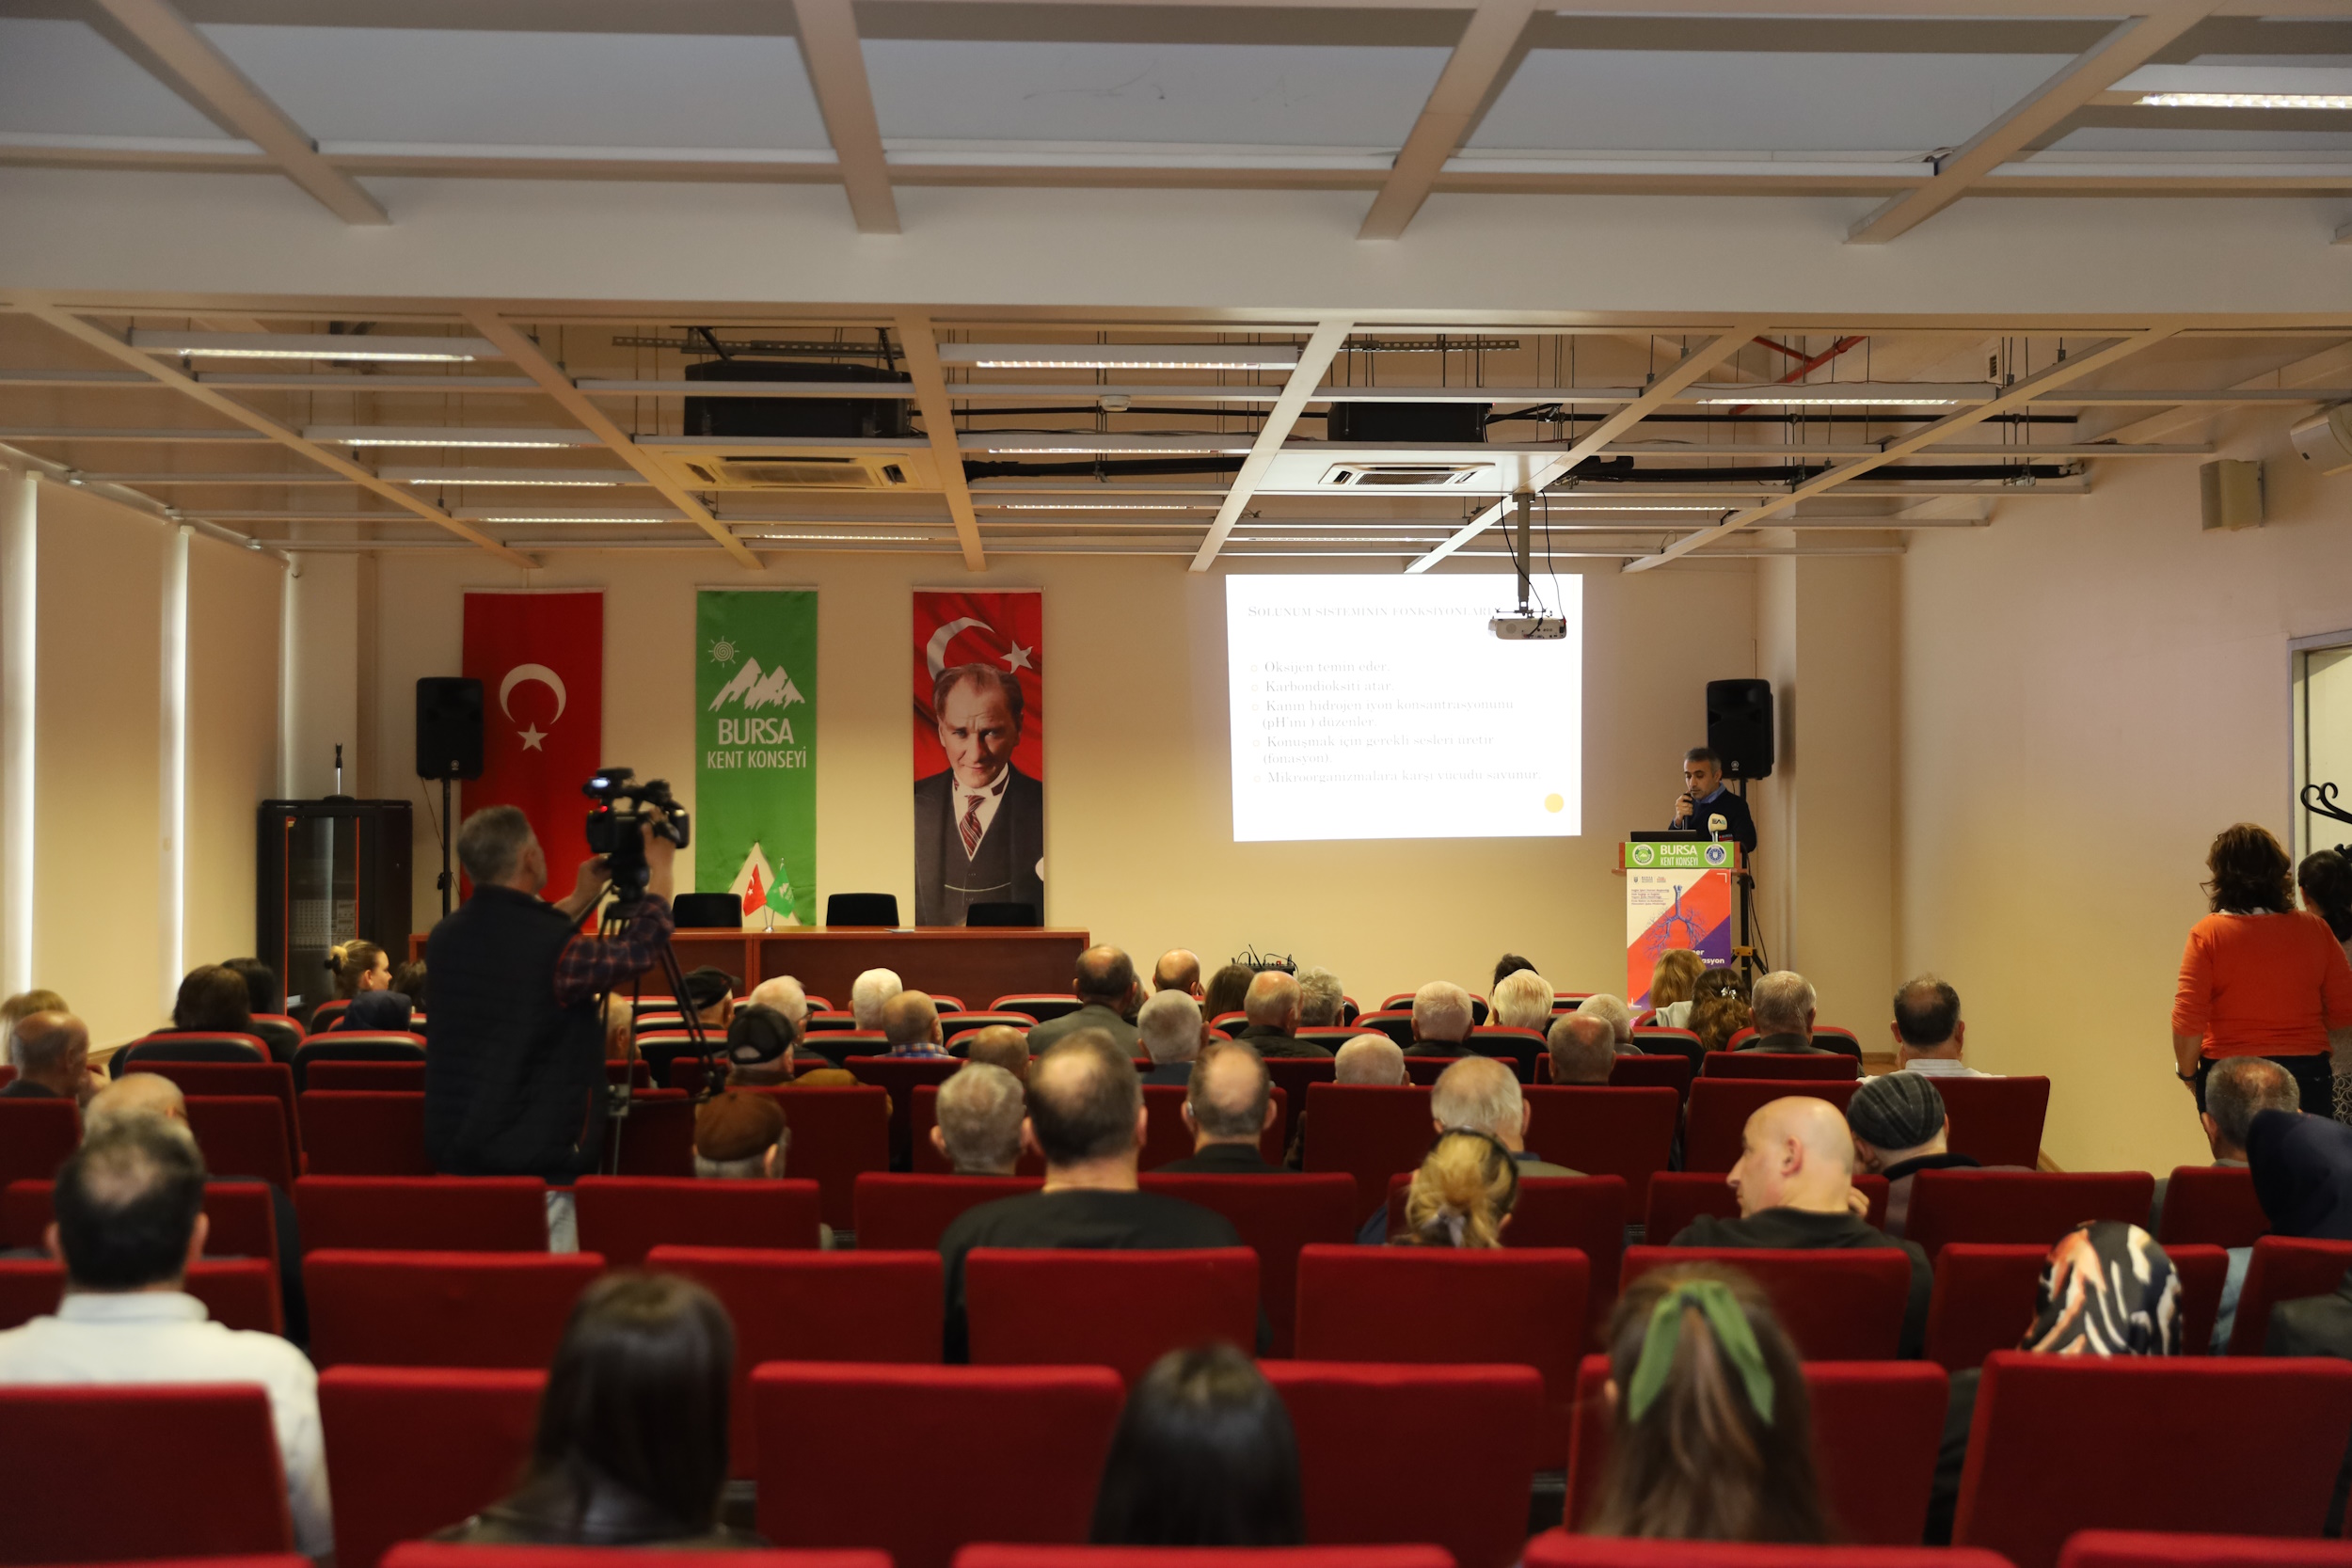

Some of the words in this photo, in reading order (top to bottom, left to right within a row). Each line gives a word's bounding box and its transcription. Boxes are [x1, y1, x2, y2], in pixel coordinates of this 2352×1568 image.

[1248, 606, 1311, 617] SOLUNUM
[1264, 660, 1313, 674] Oksijen
[1318, 661, 1355, 673] temin
[1359, 660, 1391, 673] eder.
[1265, 679, 1360, 692] Karbondioksiti
[1364, 682, 1394, 691] atar.
[1310, 699, 1362, 713] hidrojen
[1366, 700, 1392, 712] iyon
[1397, 698, 1514, 712] konsantrasyonunu
[1318, 716, 1377, 728] düzenler.
[718, 718, 794, 745] BURSA
[1267, 735, 1335, 749] Konuşmak
[1366, 735, 1409, 747] gerekli
[1413, 734, 1454, 745] sesleri
[707, 751, 743, 768] KENT
[748, 746, 806, 768] KONSEYİ
[1263, 752, 1332, 766] (fonasyon).
[1268, 769, 1397, 784] Mikroorganizmalara
[1402, 769, 1434, 783] karşı
[1660, 845, 1697, 855] BURSA
[1660, 856, 1675, 866] KENT
[1676, 855, 1699, 866] KONSEYİ
